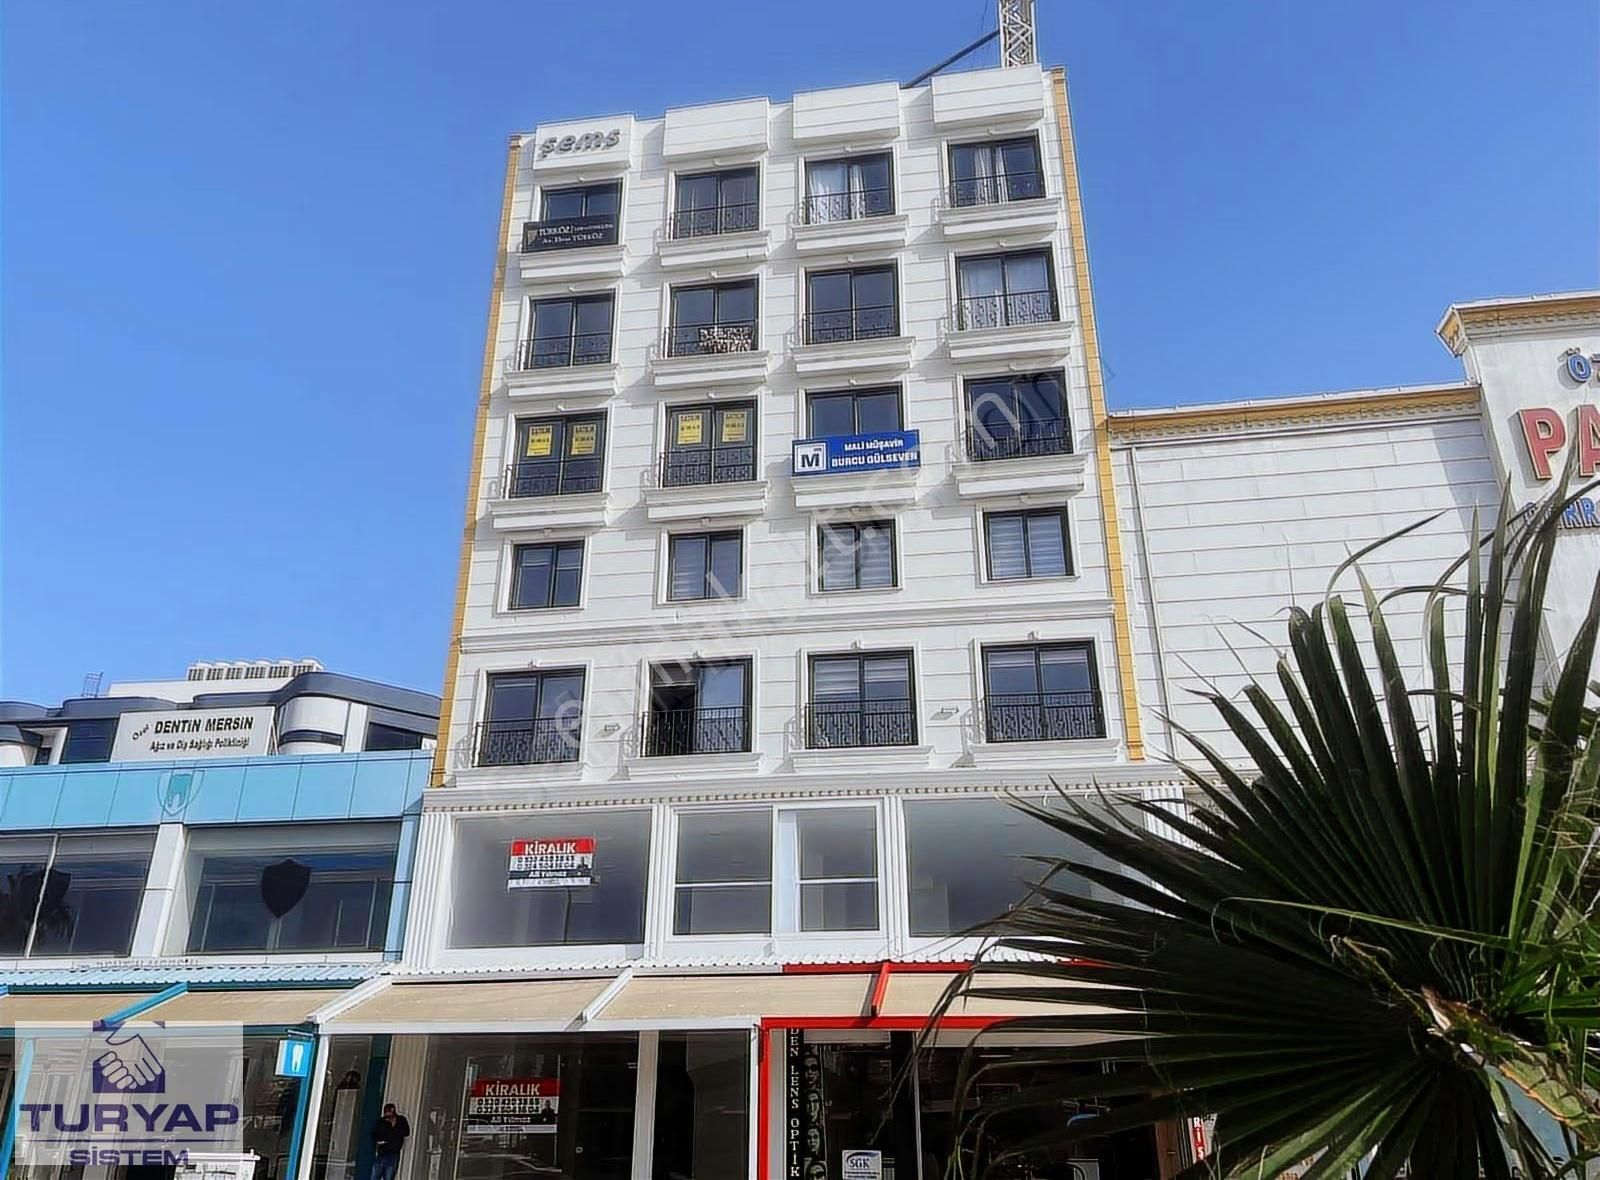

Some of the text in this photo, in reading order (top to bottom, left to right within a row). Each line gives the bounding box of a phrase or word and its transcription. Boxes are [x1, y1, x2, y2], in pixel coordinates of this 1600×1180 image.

[831, 455, 865, 467] BURCU
[525, 841, 577, 855] KİRALIK
[485, 1080, 541, 1096] KİRALIK
[790, 1065, 800, 1109] LENS
